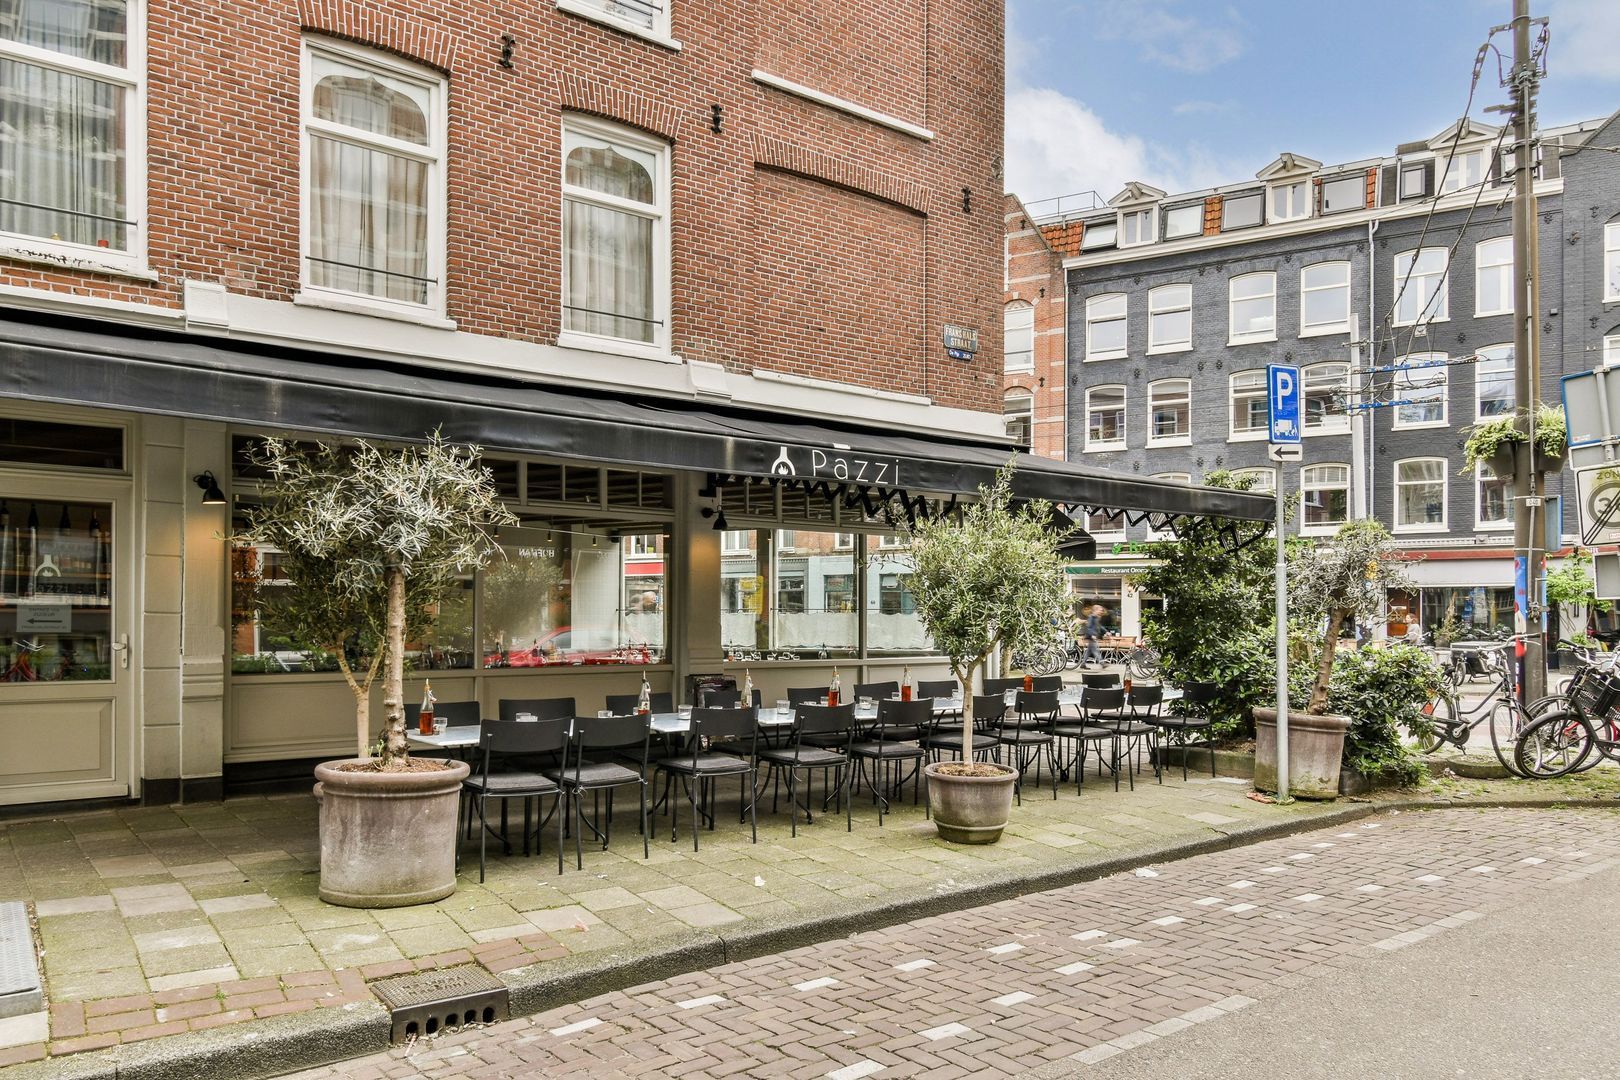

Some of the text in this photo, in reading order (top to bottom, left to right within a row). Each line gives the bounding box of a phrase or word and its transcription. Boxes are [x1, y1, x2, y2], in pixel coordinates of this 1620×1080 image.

[945, 327, 962, 338] FRANS
[950, 337, 971, 349] STRAAT
[1276, 371, 1293, 410] P
[812, 449, 899, 485] Pazzi
